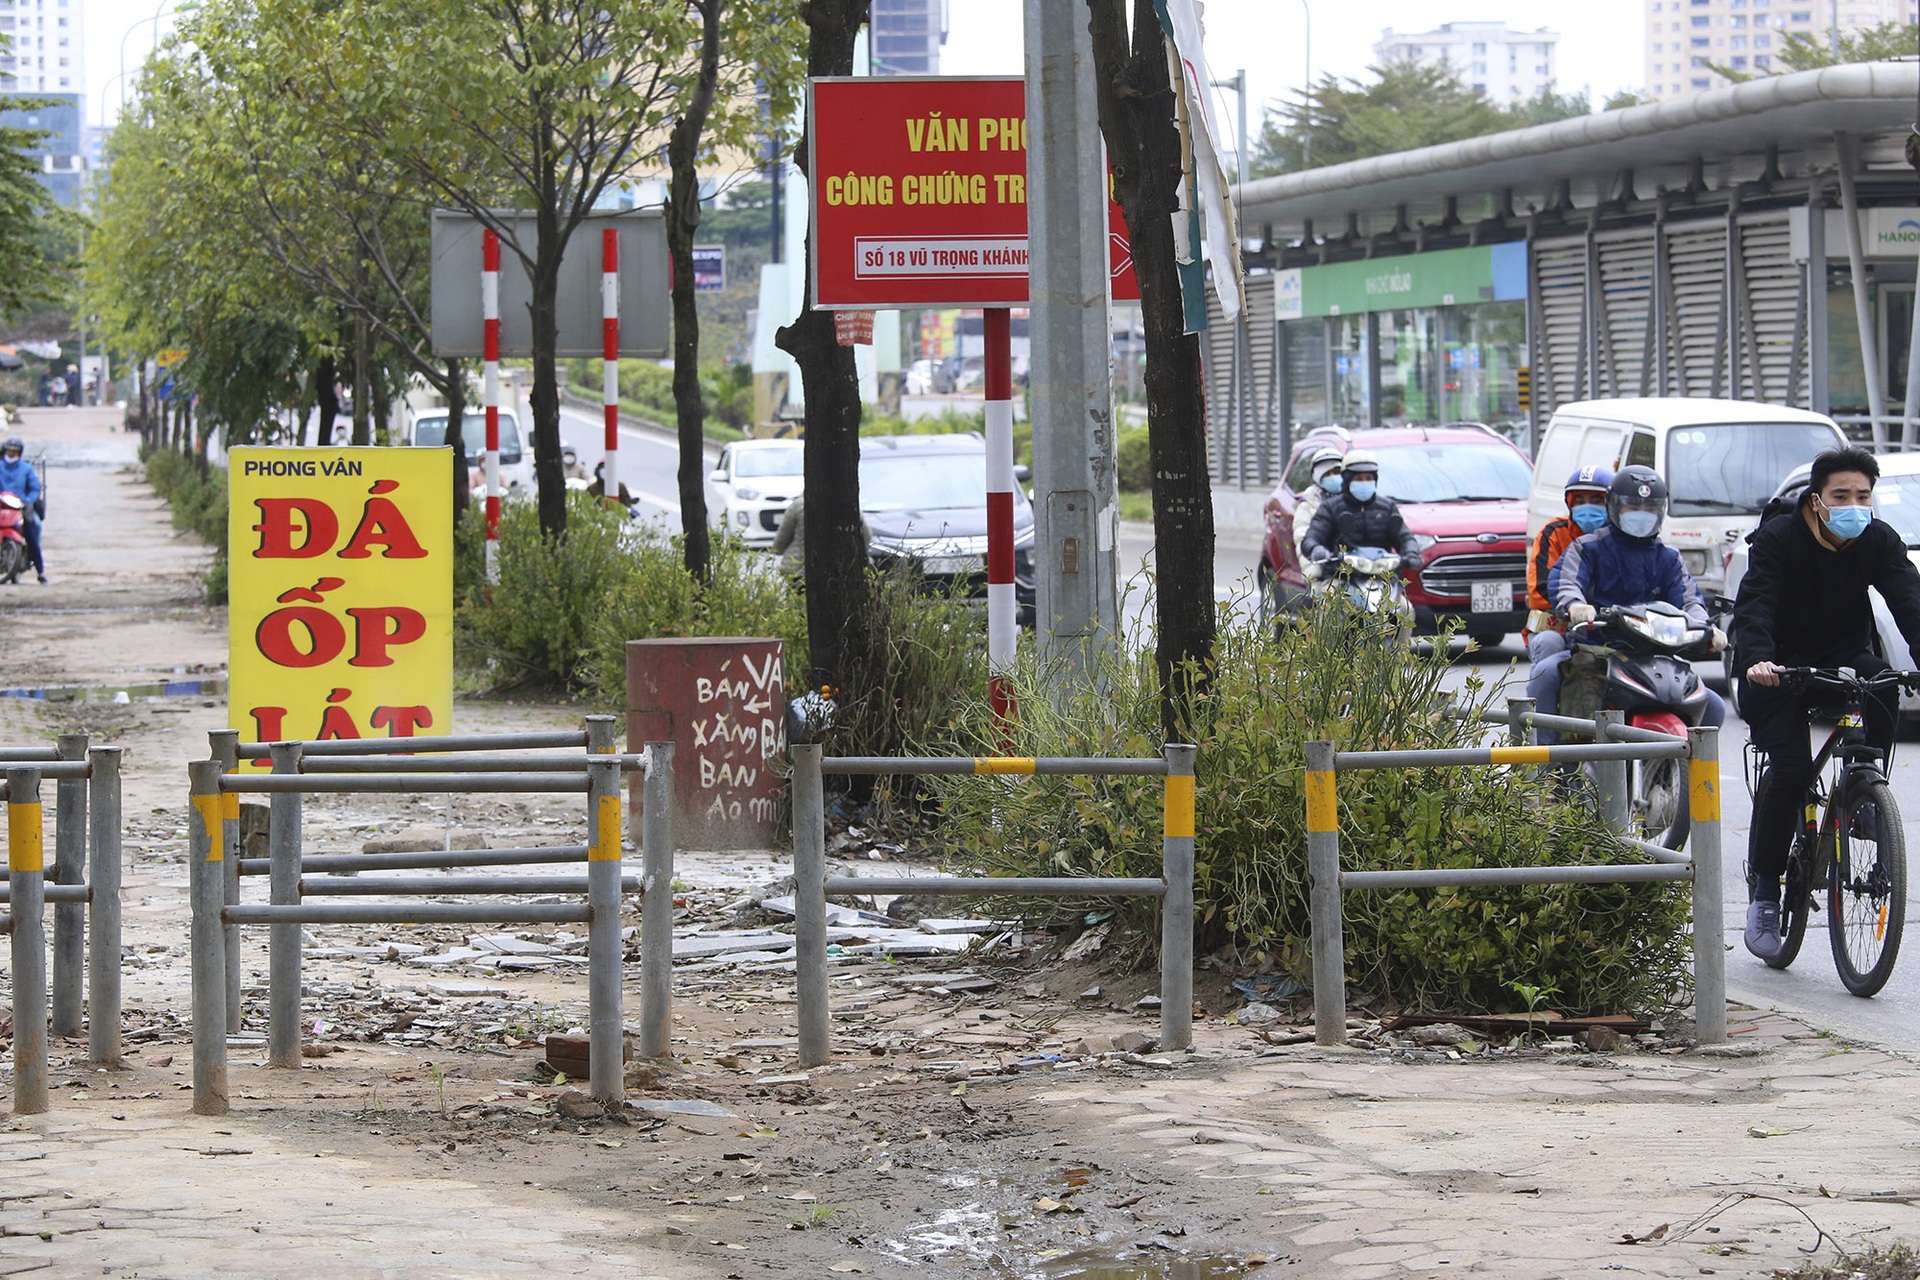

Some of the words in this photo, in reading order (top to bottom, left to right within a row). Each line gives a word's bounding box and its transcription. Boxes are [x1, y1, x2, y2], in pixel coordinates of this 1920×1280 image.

[906, 111, 968, 152] VĂN
[826, 171, 894, 206] CÔNG
[902, 170, 987, 205] CHỨNG
[865, 245, 884, 268] SỐ
[889, 250, 905, 266] 18
[910, 249, 928, 266] VŨ
[932, 249, 979, 270] TRỌNG
[982, 248, 1029, 266] KHÁNH
[244, 461, 316, 476] PHONG
[320, 457, 363, 476] VÂN
[251, 479, 429, 560] ĐÁ
[1481, 584, 1502, 597] 30F
[255, 576, 427, 668] ỐP
[697, 659, 750, 703] BÁN
[742, 642, 784, 694] VÁ
[700, 750, 757, 789] BÁN
